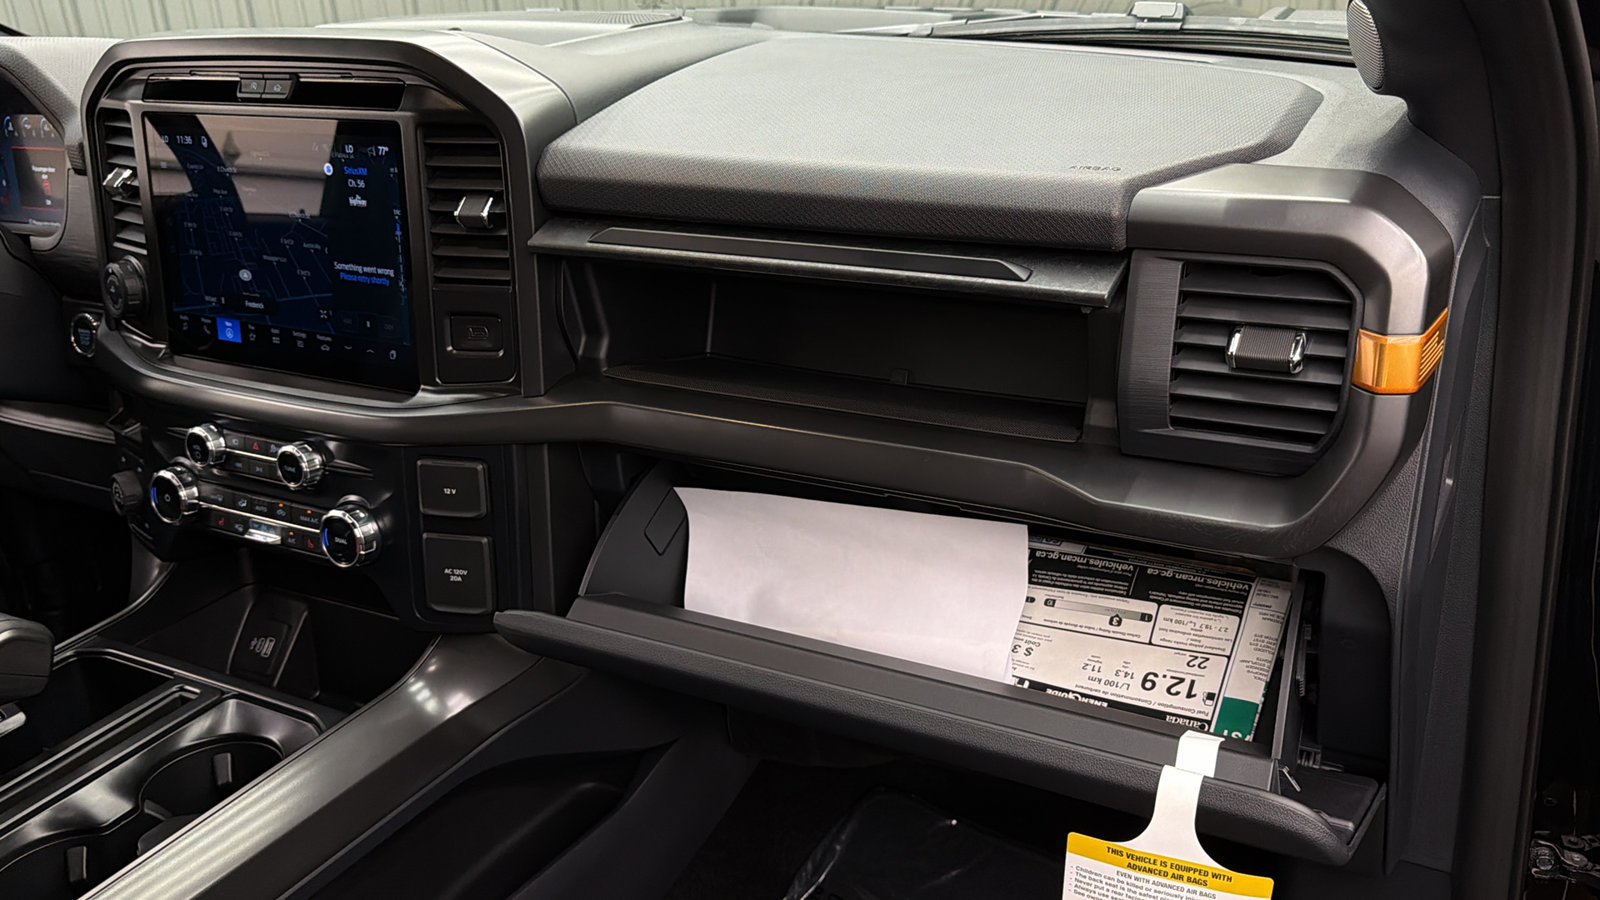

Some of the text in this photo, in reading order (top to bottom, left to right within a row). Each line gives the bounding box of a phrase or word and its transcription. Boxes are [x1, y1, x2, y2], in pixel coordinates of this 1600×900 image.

[176, 136, 192, 144] 11:36
[344, 144, 354, 153] LO
[334, 261, 363, 273] Something
[377, 268, 394, 277] wrong
[334, 536, 347, 544] DUAL
[1112, 615, 1118, 626] 3
[1011, 644, 1032, 655] $ 3
[1186, 655, 1209, 668] 22
[1082, 663, 1100, 672] 11.2
[1114, 669, 1133, 678] 14.3
[1104, 679, 1129, 689] L/100
[1141, 672, 1195, 698] 12.9
[1110, 693, 1151, 704] Consommation
[1157, 703, 1194, 713] Consumption
[1166, 715, 1207, 730] Canada
[1107, 846, 1123, 856] THIS
[1126, 852, 1156, 864] VEHICLE
[1170, 863, 1208, 876] EQUIPPED
[1212, 872, 1231, 881] WITH
[1127, 862, 1168, 876] ADVANCED
[1186, 876, 1207, 886] BAGS
[1074, 878, 1093, 886] Never
[1076, 866, 1101, 876] Children
[1126, 881, 1143, 889] killed
[1154, 889, 1183, 900] seriously
[1116, 870, 1131, 878] EVEN
[1152, 880, 1184, 891] ADVANCED
[1199, 891, 1215, 899] BAGS
[1074, 884, 1097, 893] Always
